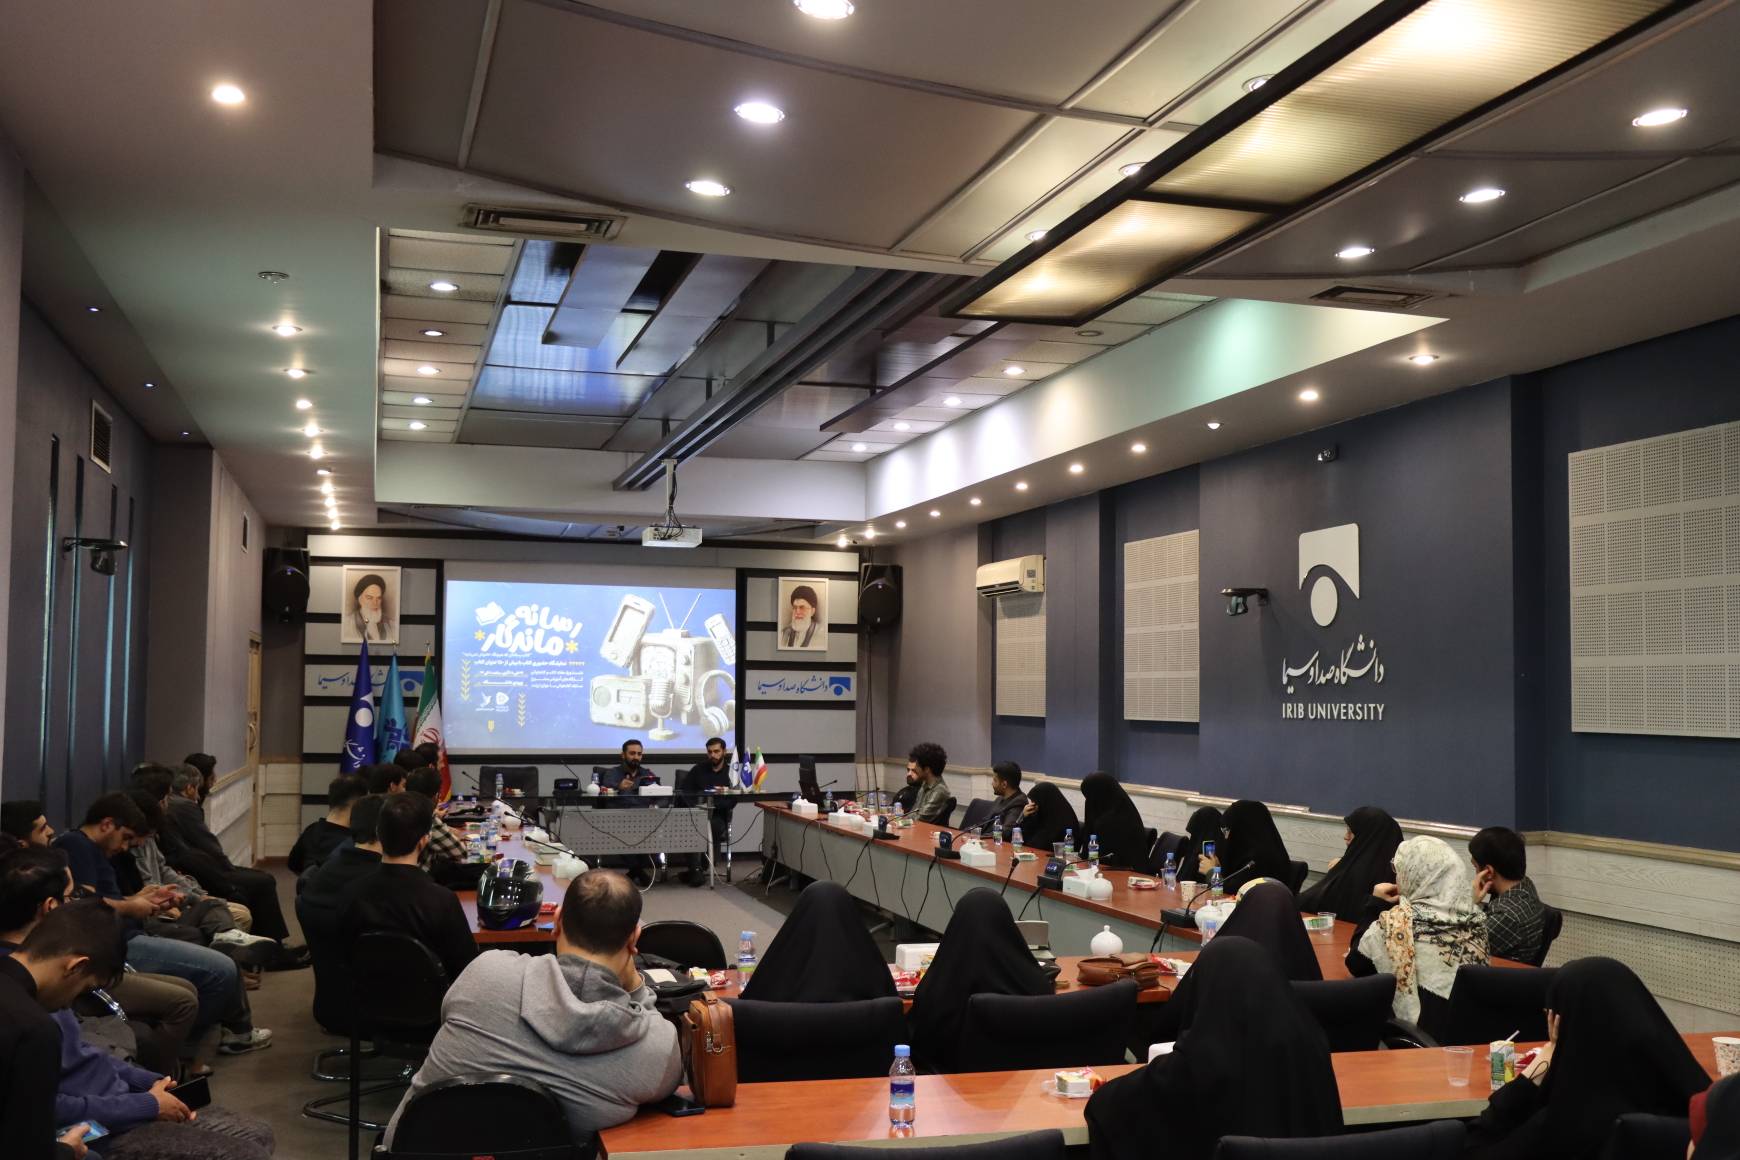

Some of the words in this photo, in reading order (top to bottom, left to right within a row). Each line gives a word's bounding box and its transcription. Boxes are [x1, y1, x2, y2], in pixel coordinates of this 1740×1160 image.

[481, 614, 564, 656] ماندگار
[515, 603, 583, 639] رسانه
[1282, 702, 1305, 719] IRIB
[1308, 703, 1385, 721] UNIVERSITY
